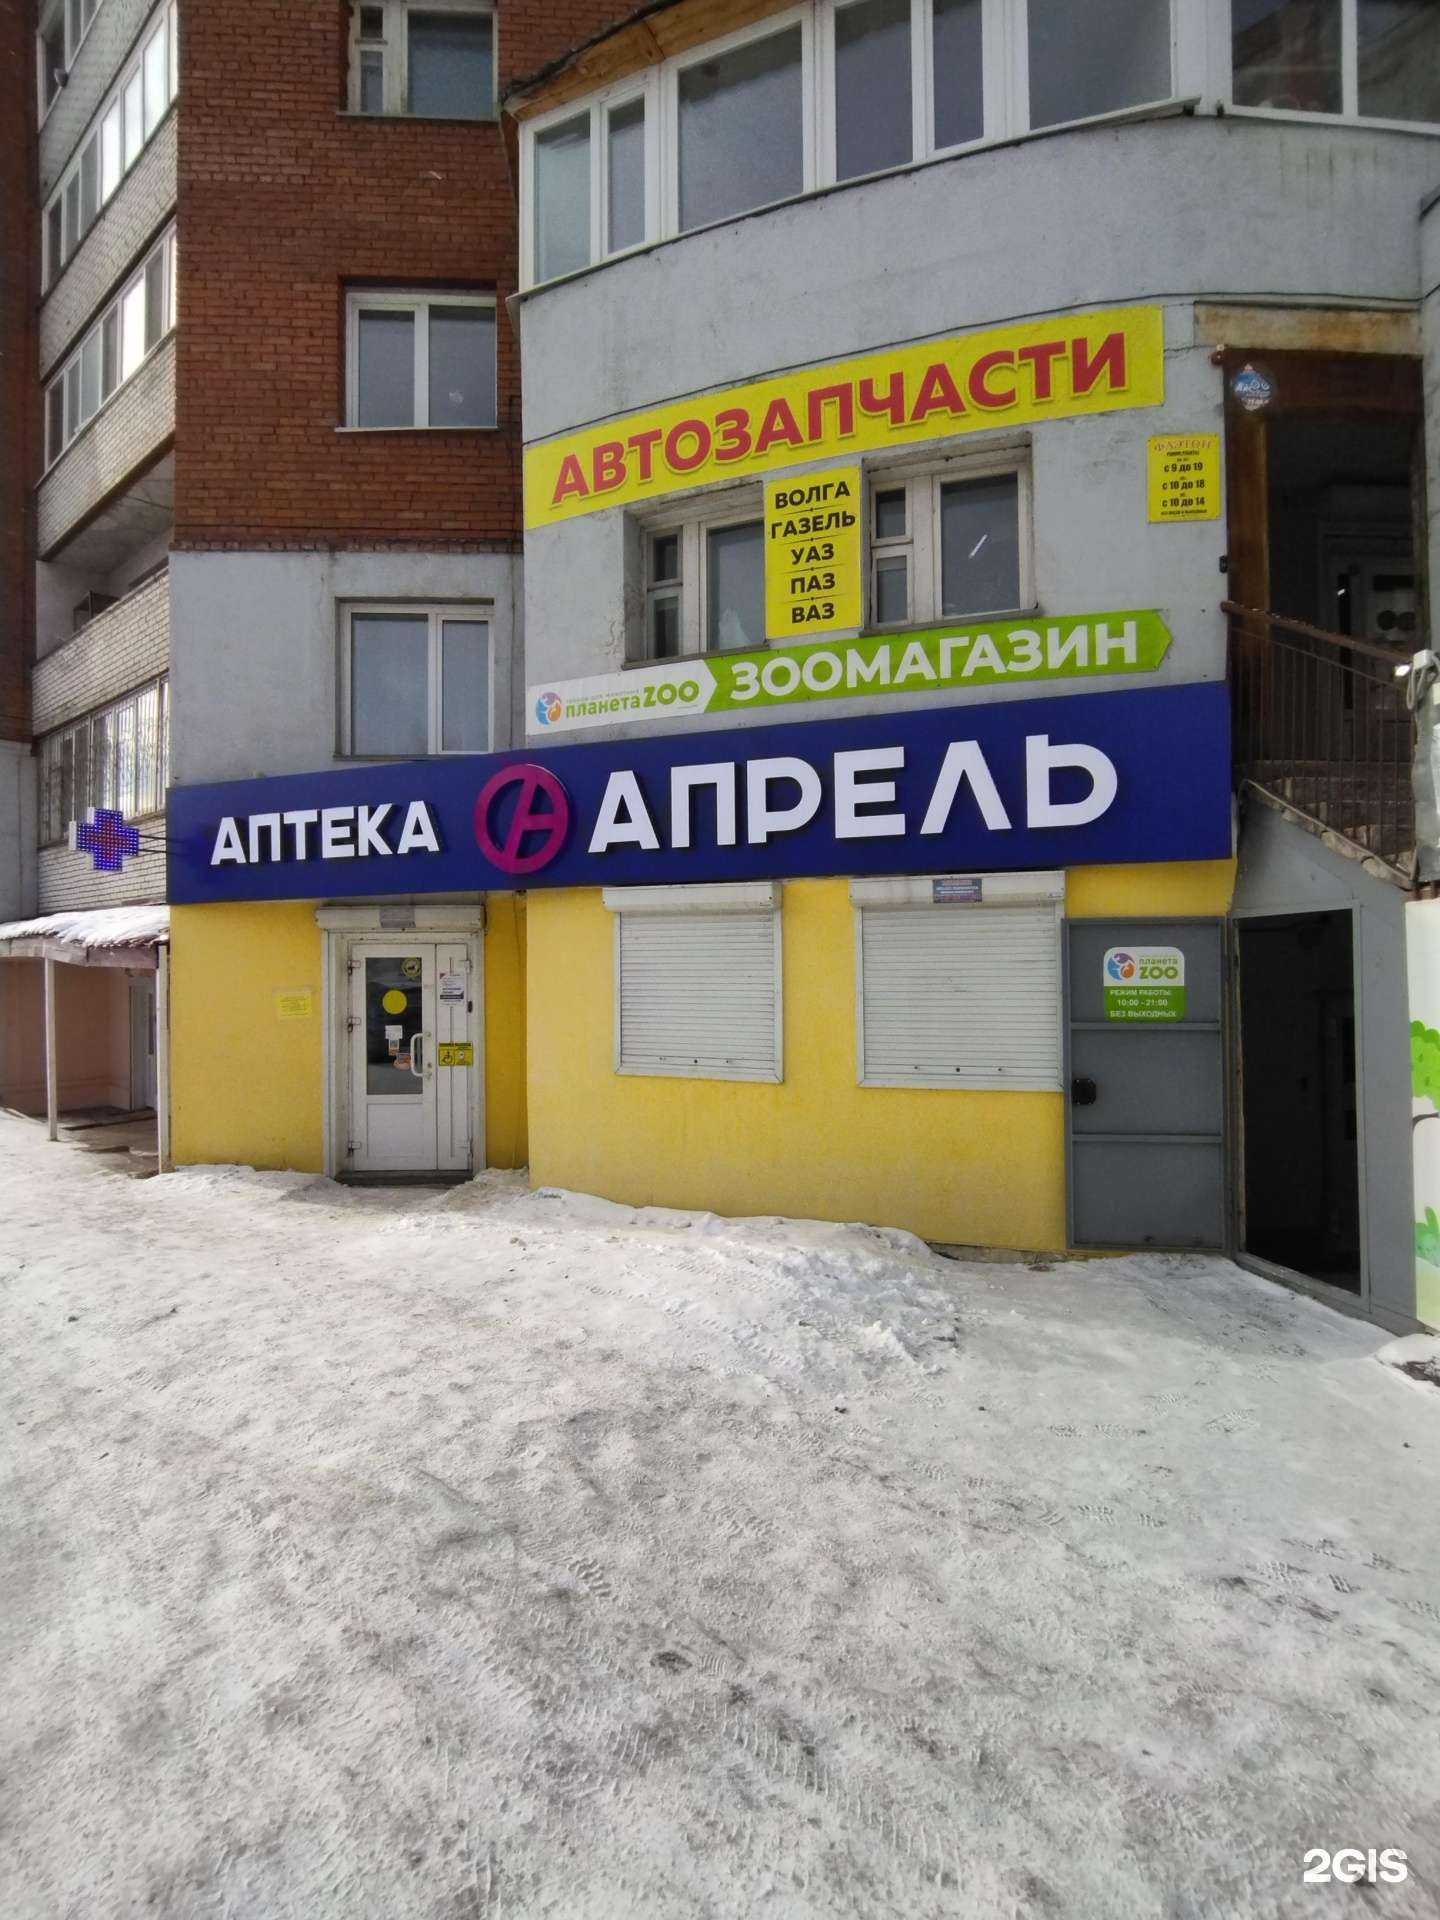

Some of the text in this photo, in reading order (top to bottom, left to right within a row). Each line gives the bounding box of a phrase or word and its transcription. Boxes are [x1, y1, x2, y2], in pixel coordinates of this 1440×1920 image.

[551, 332, 1127, 505] АВТОЗАПЧАСТИ
[1171, 463, 1177, 472] 9
[1179, 463, 1191, 473] до
[1194, 461, 1203, 471] 19
[775, 481, 850, 509] ВОЛГА
[1170, 480, 1179, 490] 10
[1181, 480, 1193, 490] до
[1196, 479, 1205, 488] 18
[1170, 498, 1179, 507] 10
[1181, 498, 1193, 507] до
[771, 510, 856, 539] ГАЗЕЛЬ
[791, 543, 834, 565] УАЗ
[791, 573, 836, 595] ПАЗ
[791, 603, 835, 623] ВАЗ
[730, 620, 1137, 701] ЗООМАГАЗИН
[587, 734, 1118, 853] АПРЕЛЬ
[210, 800, 440, 866] АПТЕКА
[1139, 966, 1178, 979] ZOO
